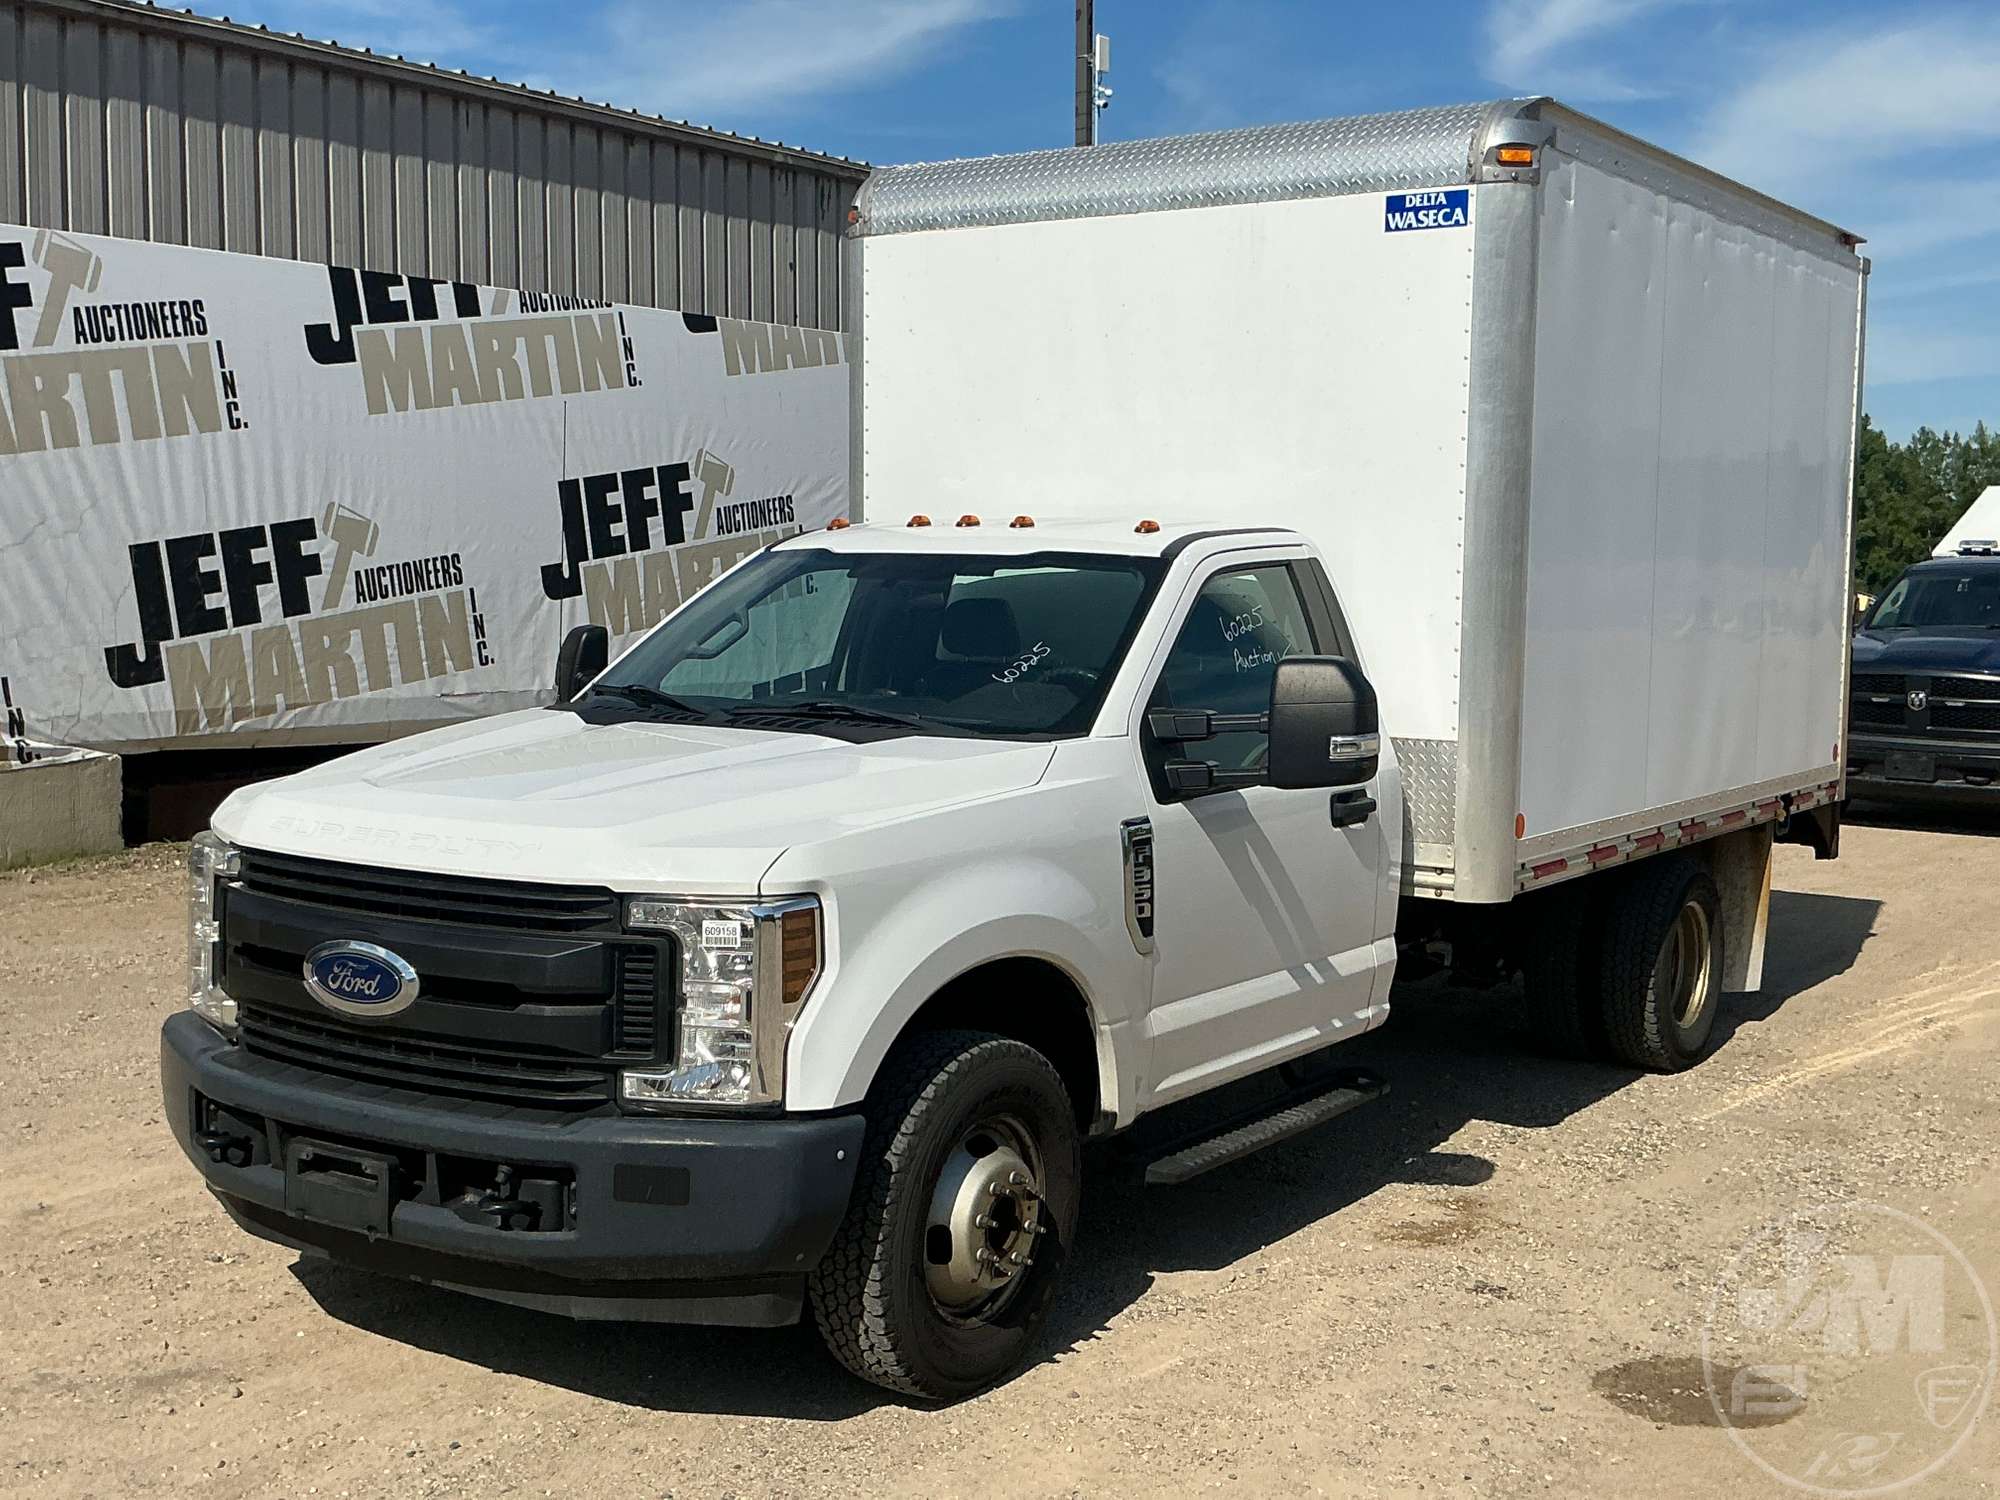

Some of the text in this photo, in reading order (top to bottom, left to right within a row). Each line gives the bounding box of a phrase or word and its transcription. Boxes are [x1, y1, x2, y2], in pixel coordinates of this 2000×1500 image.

[1386, 207, 1466, 230] WASECA
[1405, 192, 1447, 208] DELTA
[73, 299, 209, 345] AUCTIONEERS
[618, 311, 642, 387] INC.
[215, 339, 249, 430] INC.
[356, 313, 625, 416] MARTIN
[0, 341, 223, 454] RTIN
[540, 461, 795, 600] JEFF AUCTIONEERS
[104, 517, 464, 689] JEFF AUCTIONEERS
[469, 586, 495, 667] INC.
[1219, 604, 1263, 641] 60225
[166, 590, 474, 736] MARTIN
[991, 640, 1051, 683] 60225
[1233, 646, 1277, 673] Auction
[704, 926, 737, 936] 609158
[328, 960, 381, 997] Ford
